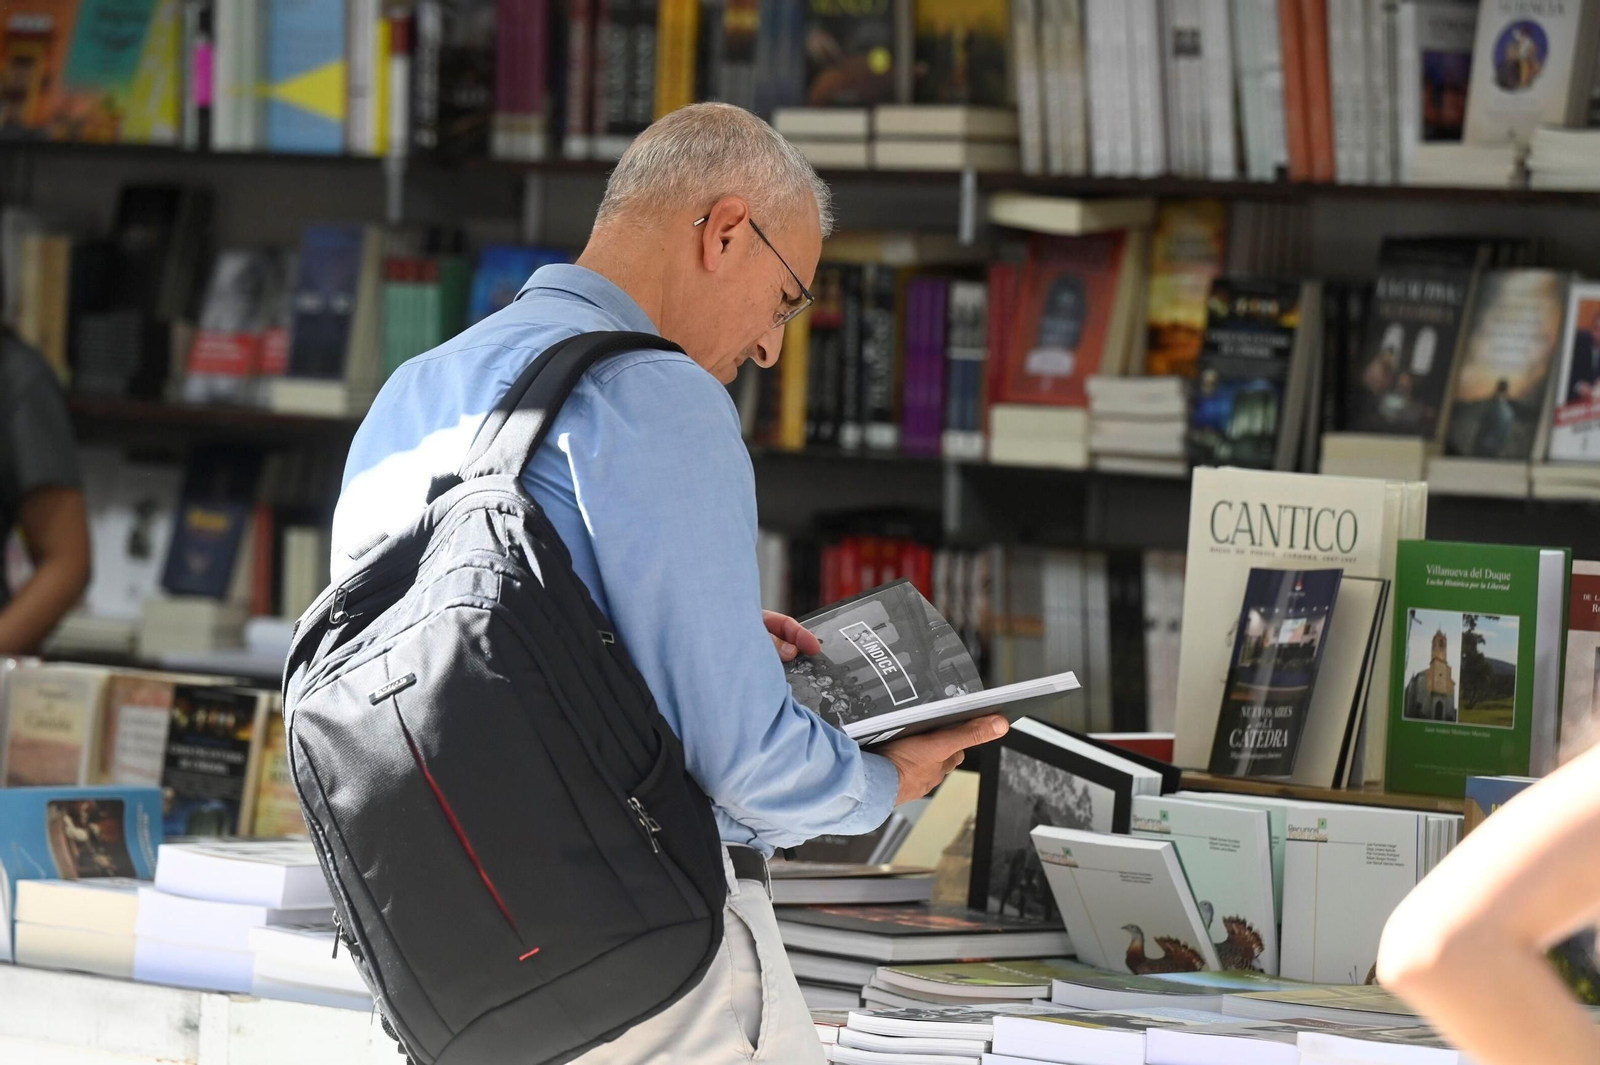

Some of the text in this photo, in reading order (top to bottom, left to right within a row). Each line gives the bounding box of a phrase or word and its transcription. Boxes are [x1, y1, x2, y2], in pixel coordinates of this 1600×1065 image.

[1210, 500, 1358, 554] CANTICO
[1426, 564, 1511, 583] Villanueva del Duque
[1469, 581, 1479, 590] por
[1486, 582, 1511, 591] Libertad
[862, 641, 898, 676] ÍNDICE
[1229, 723, 1289, 749] CÁTEDRA
